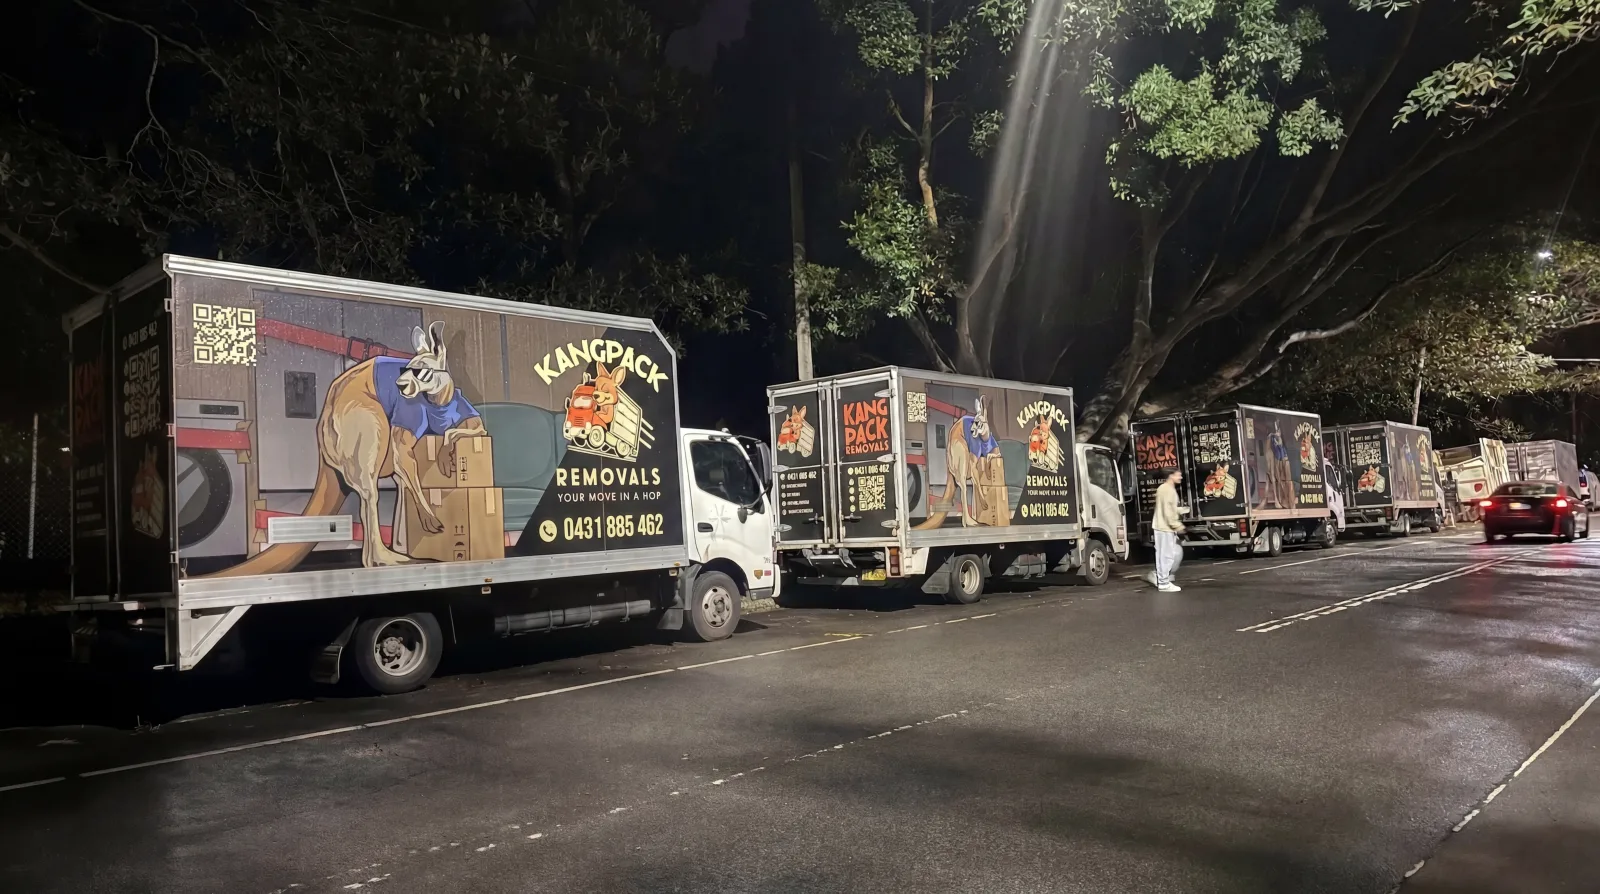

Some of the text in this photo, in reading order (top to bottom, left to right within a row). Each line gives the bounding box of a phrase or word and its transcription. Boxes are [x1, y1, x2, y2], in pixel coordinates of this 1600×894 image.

[533, 338, 669, 393] KANGPACK
[843, 398, 888, 426] KANG
[1016, 400, 1070, 432] KANGPACK
[845, 416, 889, 446] PACK
[845, 440, 889, 455] REMOVALS
[1136, 432, 1175, 452] KANG
[1137, 444, 1177, 464] PACK
[556, 467, 661, 487] REMOVALS
[1026, 475, 1068, 487] REMOVALS
[557, 491, 661, 503] YOUR MOVE IN A HOP
[1030, 503, 1044, 517] 0431
[1058, 503, 1069, 517] 462
[564, 513, 664, 541] 0431 885 462
